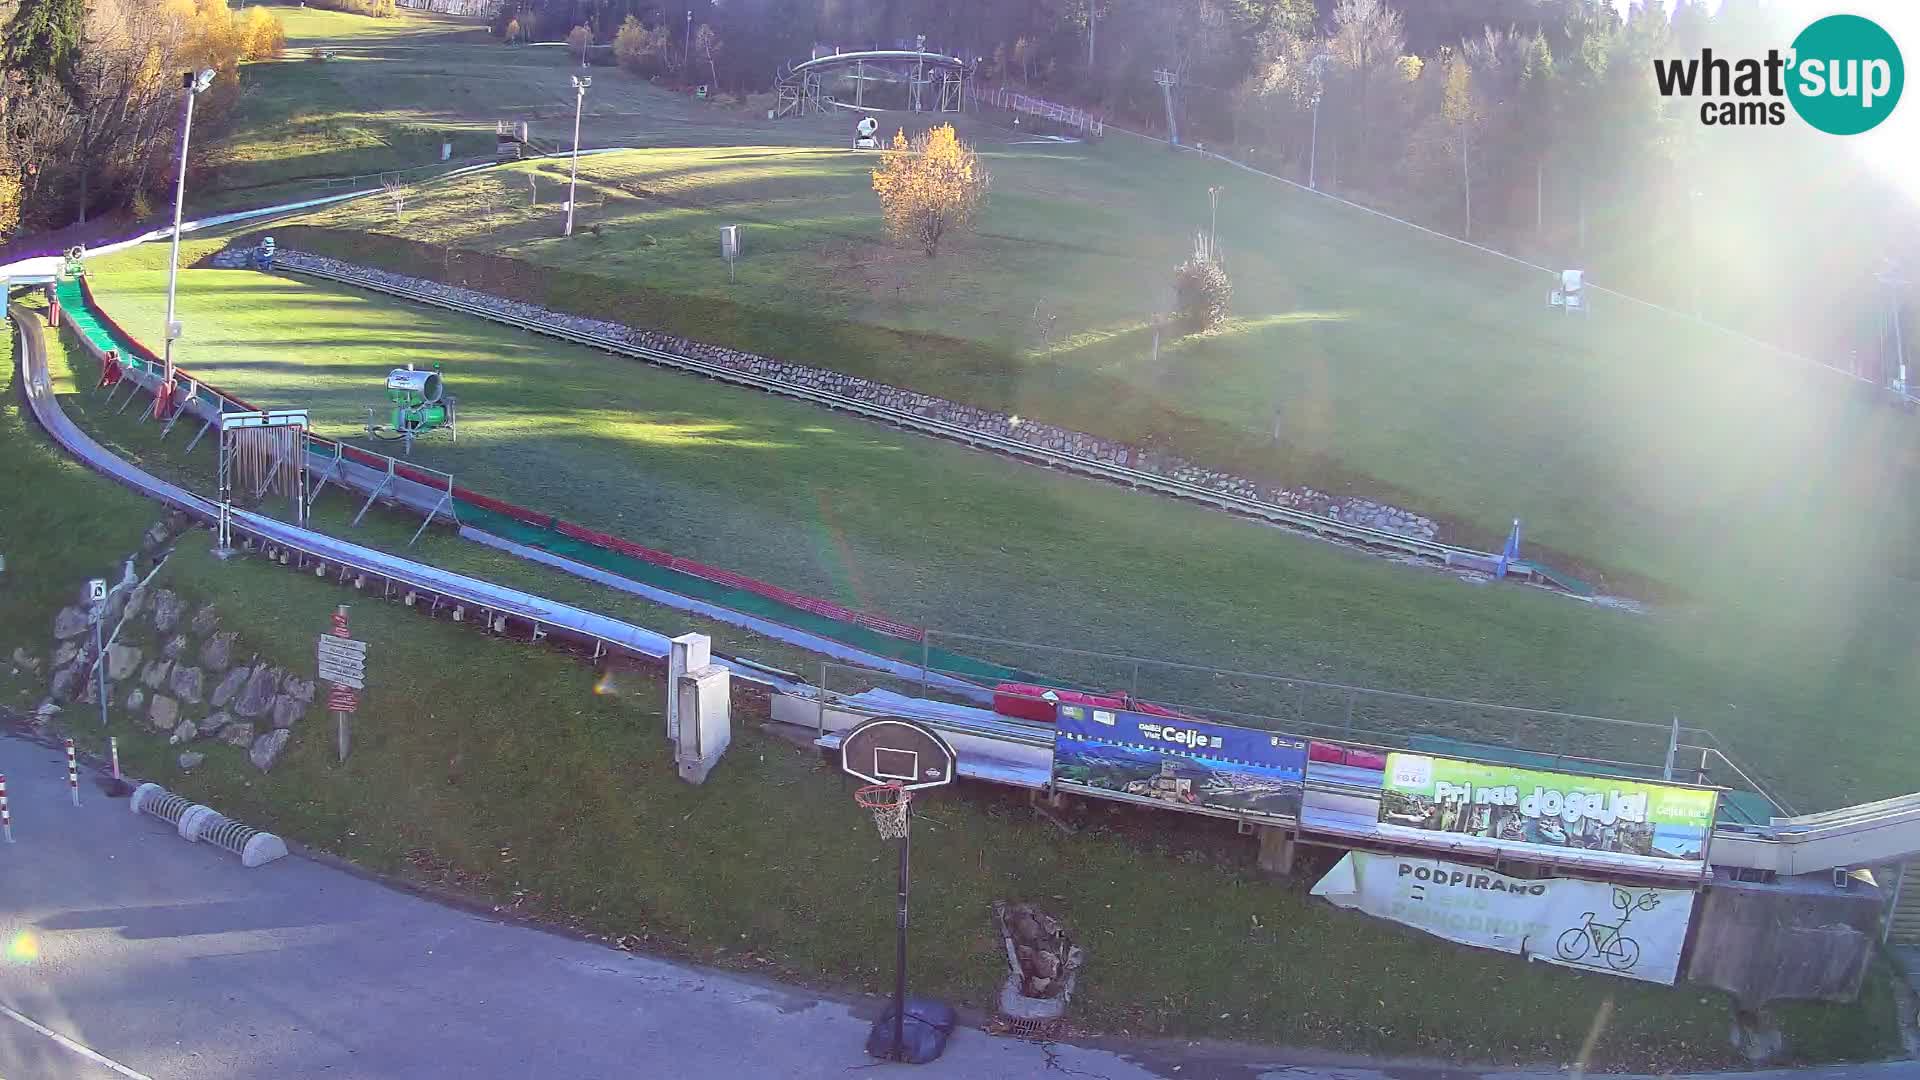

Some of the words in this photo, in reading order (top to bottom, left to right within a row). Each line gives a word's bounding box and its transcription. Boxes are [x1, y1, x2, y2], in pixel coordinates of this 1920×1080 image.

[1162, 727, 1208, 749] Celje
[1434, 781, 1472, 805] Pri
[1475, 785, 1519, 806] nas
[1398, 863, 1547, 897] PODPIRAMO
